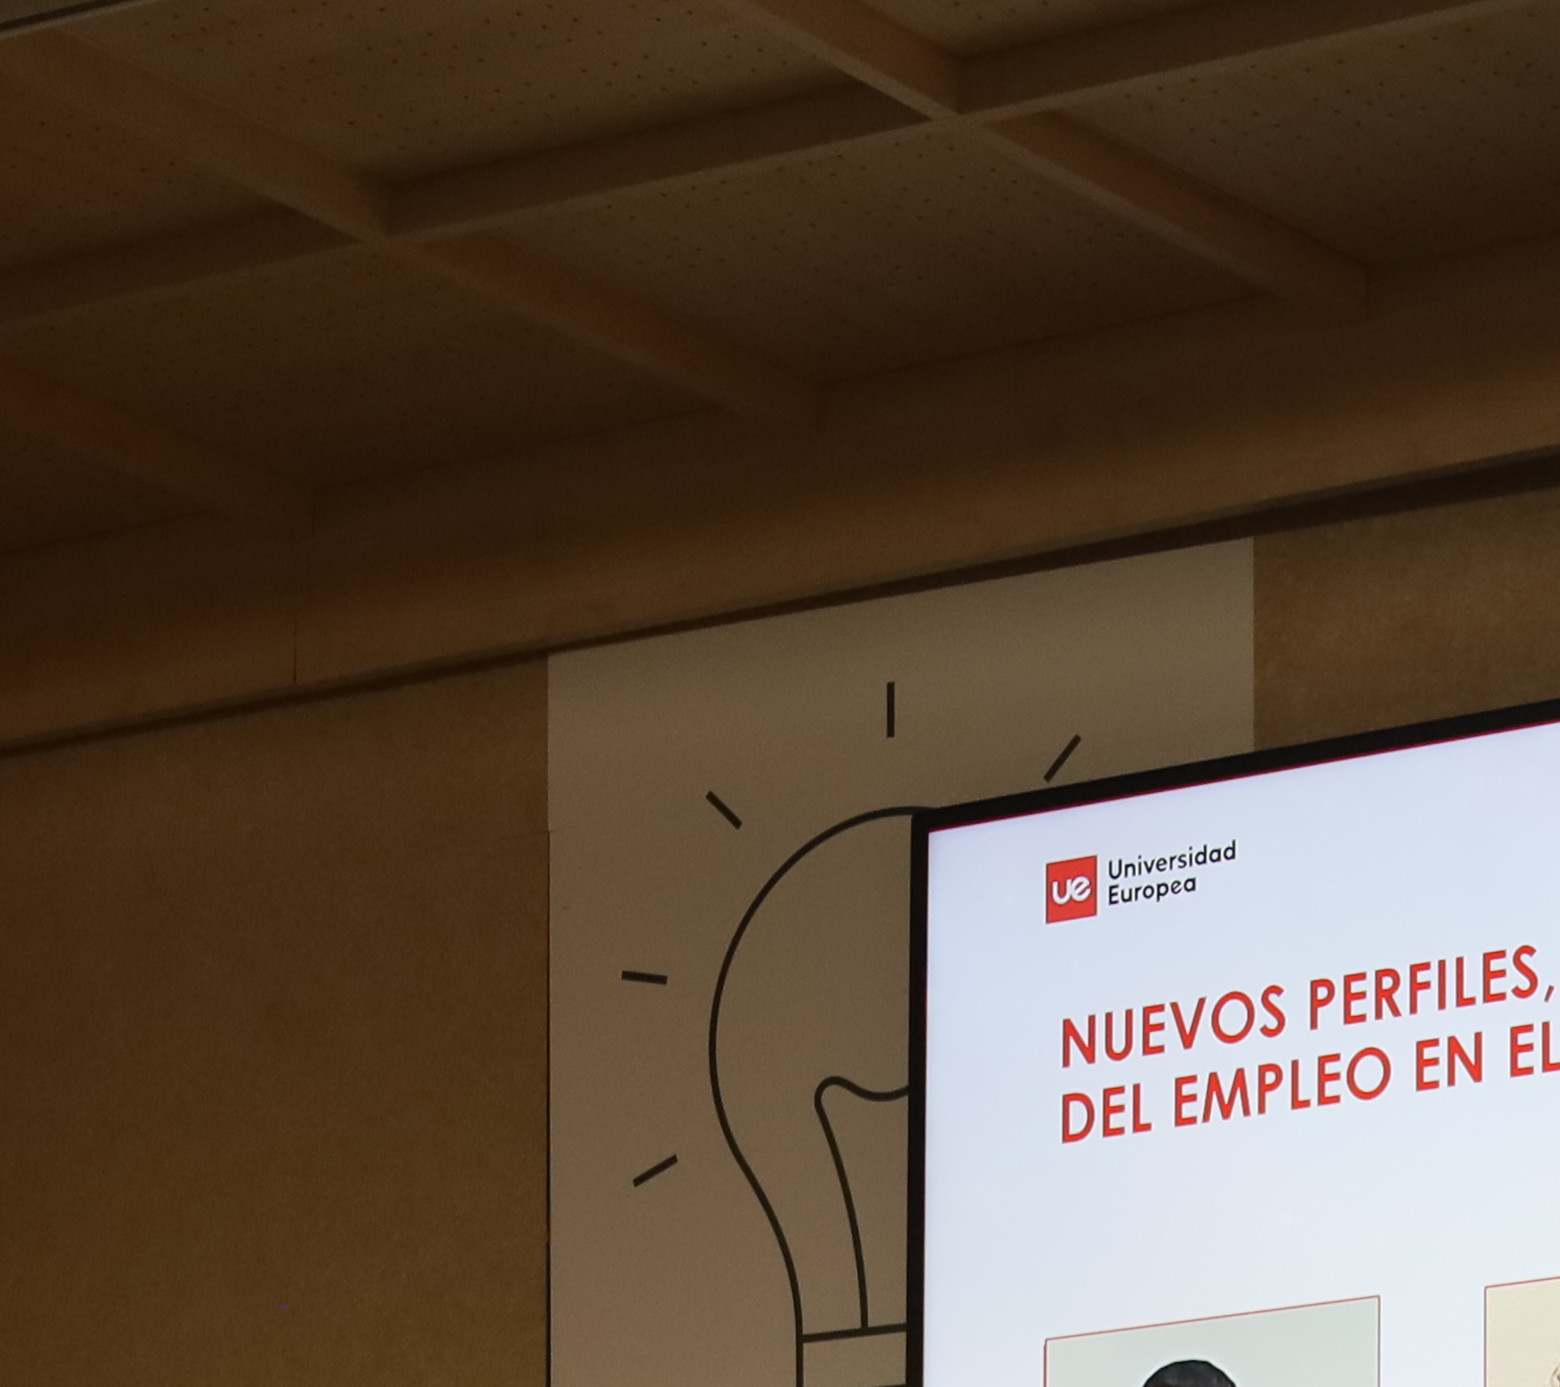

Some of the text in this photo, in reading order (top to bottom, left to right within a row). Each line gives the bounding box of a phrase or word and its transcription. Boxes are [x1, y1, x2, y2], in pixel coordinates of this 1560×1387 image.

[1108, 839, 1237, 880] Universidad
[1052, 876, 1092, 905] ue
[1108, 877, 1197, 906] Europea
[1061, 985, 1284, 1069] NUEVOS
[1309, 944, 1554, 1031] PERFILES,
[1061, 1083, 1151, 1144] DEL
[1173, 1046, 1392, 1127] EMPLEO
[1415, 1031, 1484, 1094] EN
